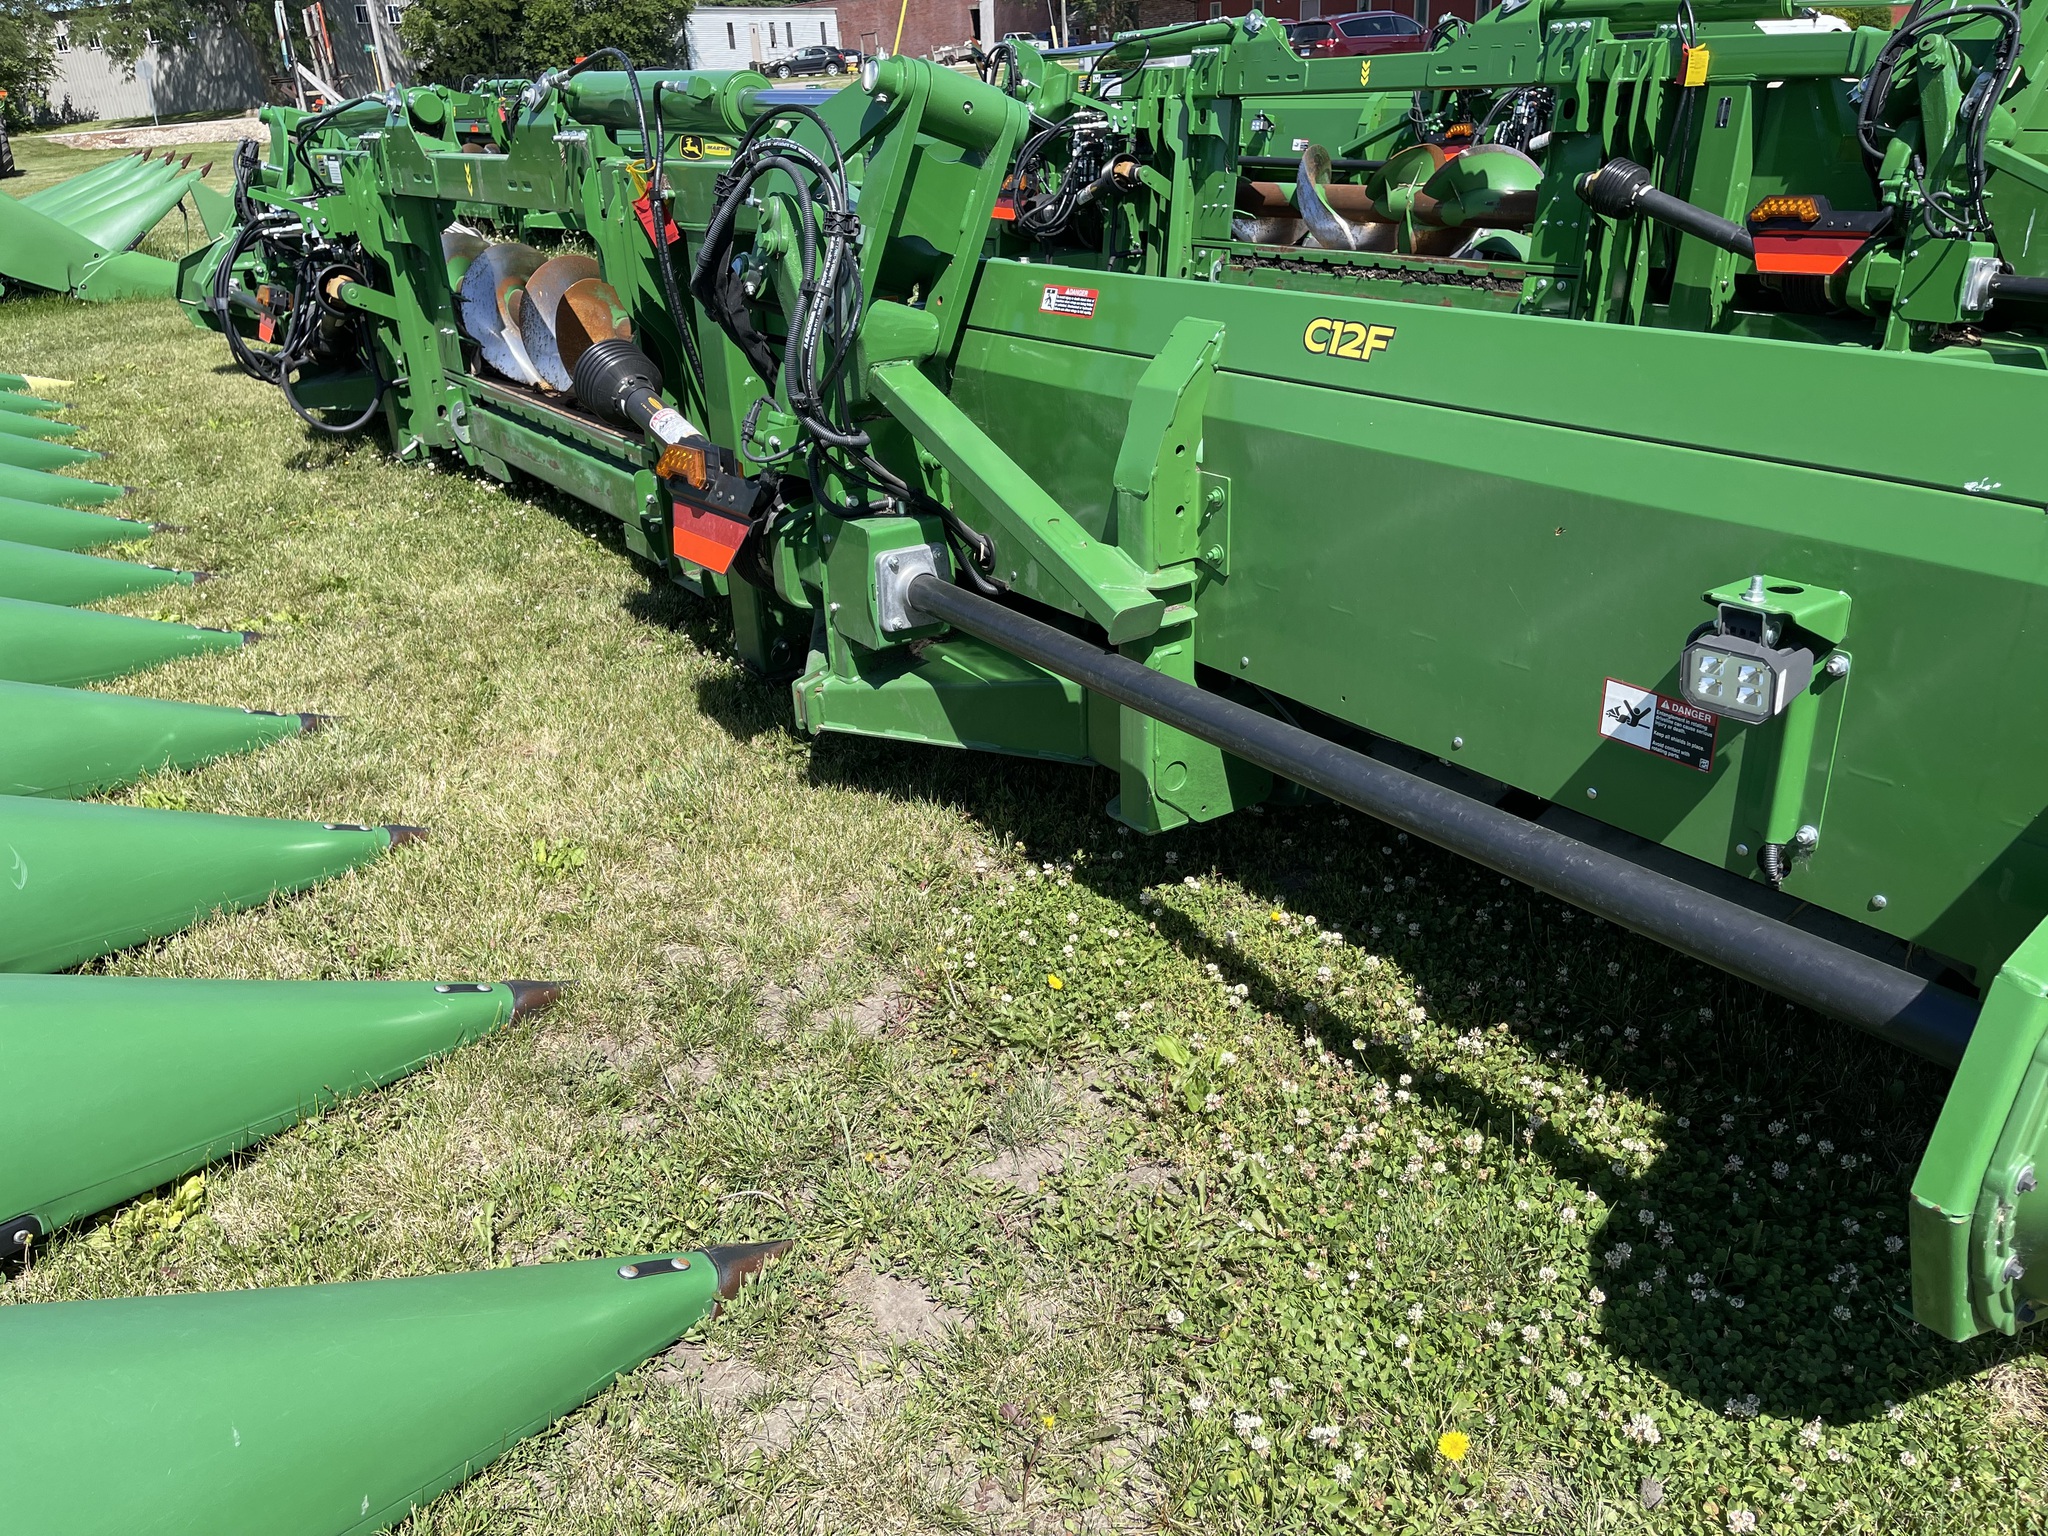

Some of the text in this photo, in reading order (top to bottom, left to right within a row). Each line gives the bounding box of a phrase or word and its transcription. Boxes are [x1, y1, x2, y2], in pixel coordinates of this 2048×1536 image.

[1303, 317, 1397, 362] C12F
[1657, 709, 1685, 723] Entanglement
[1691, 720, 1708, 731] rotating
[1672, 704, 1711, 722] DANGER
[1655, 721, 1667, 729] injury
[1673, 726, 1686, 735] death.
[1683, 724, 1695, 732] cause
[1696, 728, 1712, 738] serious
[1652, 740, 1664, 748] Avoid
[1665, 745, 1680, 753] contact
[1671, 736, 1686, 746] shields
[1692, 743, 1704, 751] place.
[1651, 746, 1667, 756] rotating
